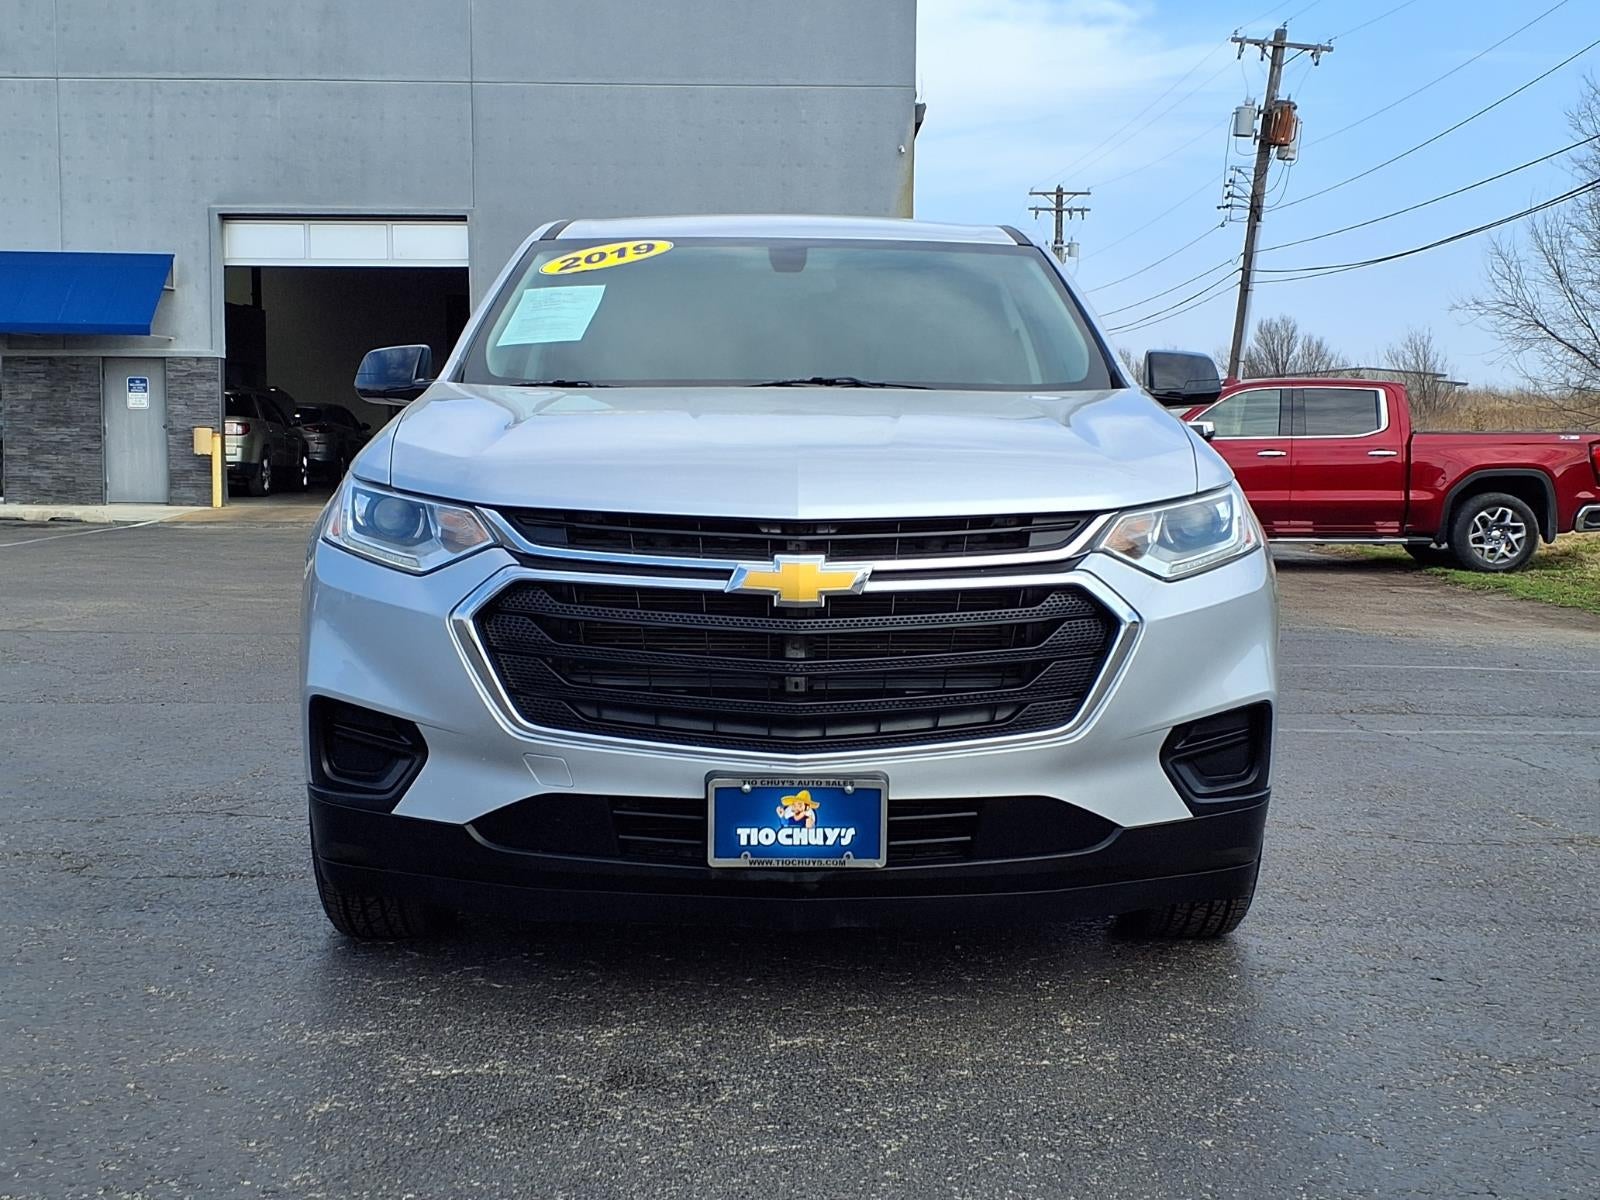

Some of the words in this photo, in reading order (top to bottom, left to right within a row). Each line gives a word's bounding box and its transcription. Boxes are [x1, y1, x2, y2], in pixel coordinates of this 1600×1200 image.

[558, 243, 656, 272] 2019
[742, 779, 758, 787] TIO
[760, 779, 795, 787] CHUY'S
[797, 779, 823, 787] AUTO
[825, 780, 855, 788] SALES
[736, 827, 776, 846] TIO
[748, 859, 847, 867] WWW.TIOCHUYS.COM
